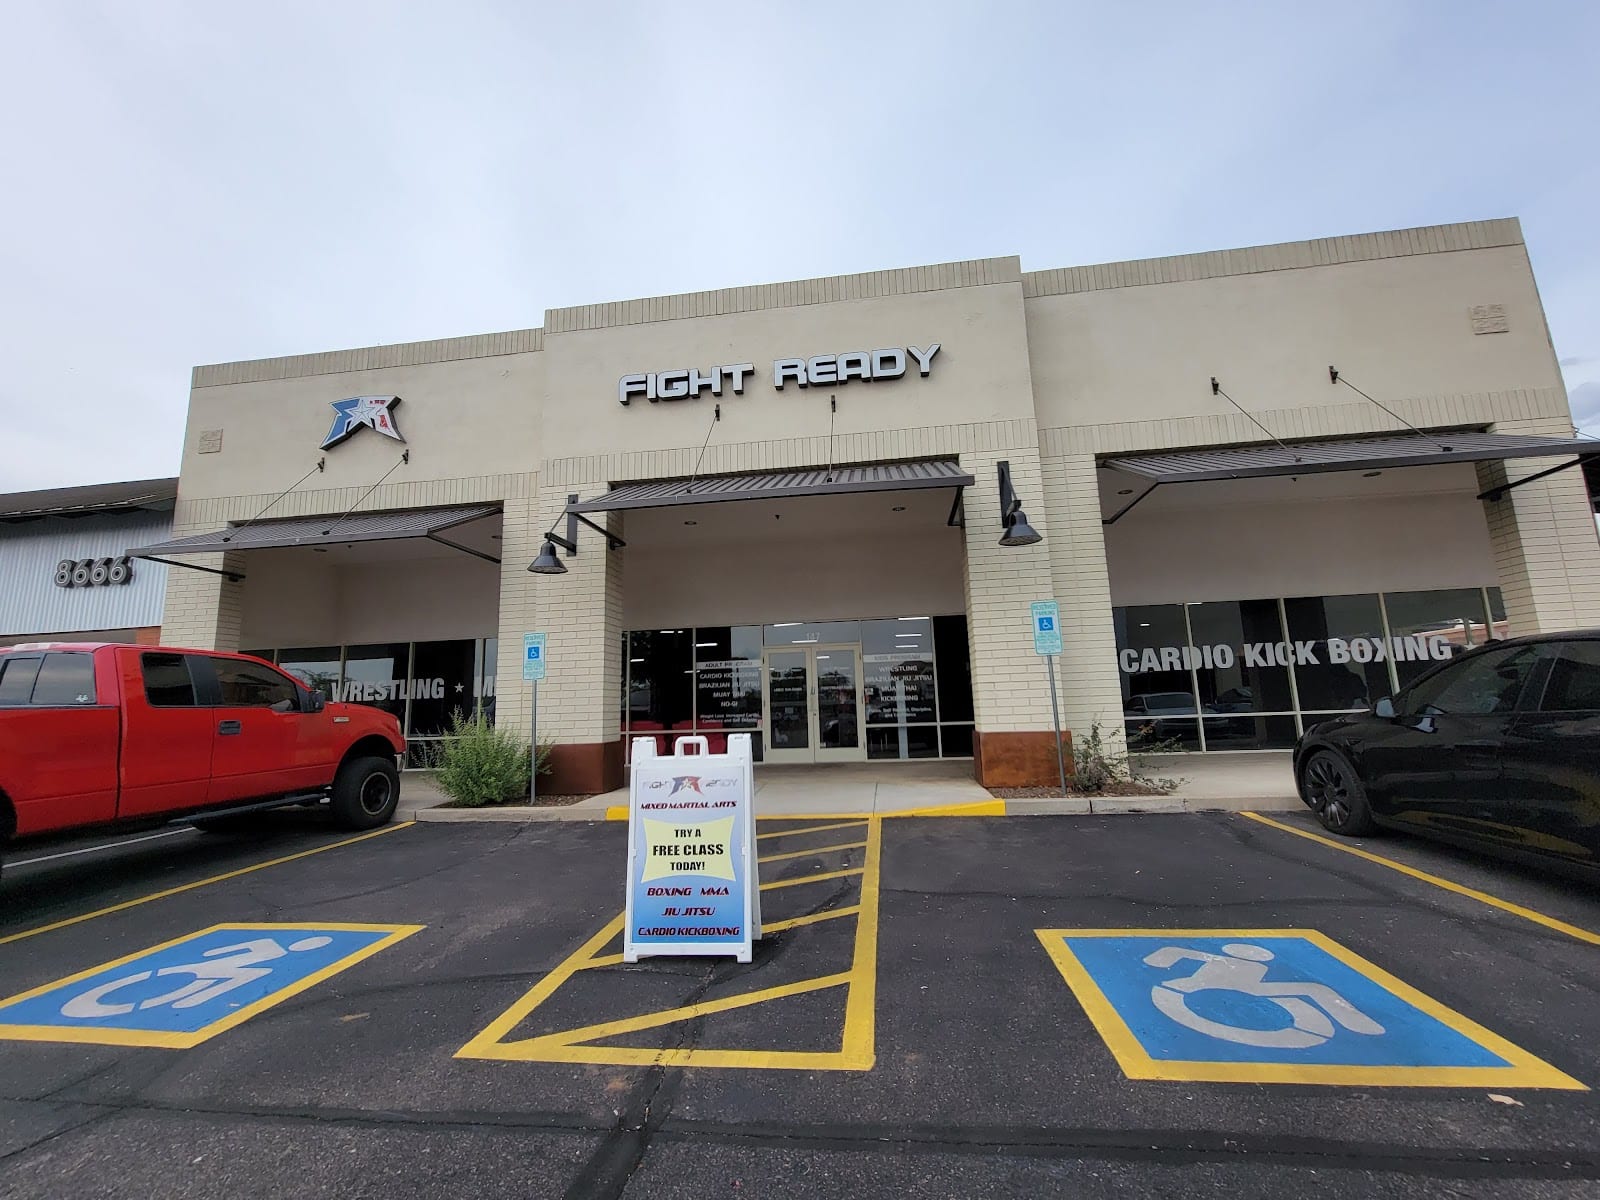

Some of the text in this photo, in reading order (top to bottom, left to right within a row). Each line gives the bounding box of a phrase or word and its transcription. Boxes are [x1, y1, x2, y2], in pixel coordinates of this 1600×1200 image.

[619, 343, 941, 405] FIGHT READY
[54, 556, 131, 588] 8666
[1119, 635, 1453, 673] CARDIO KICK BOXING
[331, 678, 445, 703] WRESTLING
[674, 829, 701, 838] TRY A
[652, 844, 724, 856] FREE CLASS
[670, 862, 705, 871] TODAY!
[647, 886, 730, 896] BOXING MMA
[662, 907, 716, 916] JIU JITSU
[638, 926, 740, 936] CARDIO KICKBOXING
